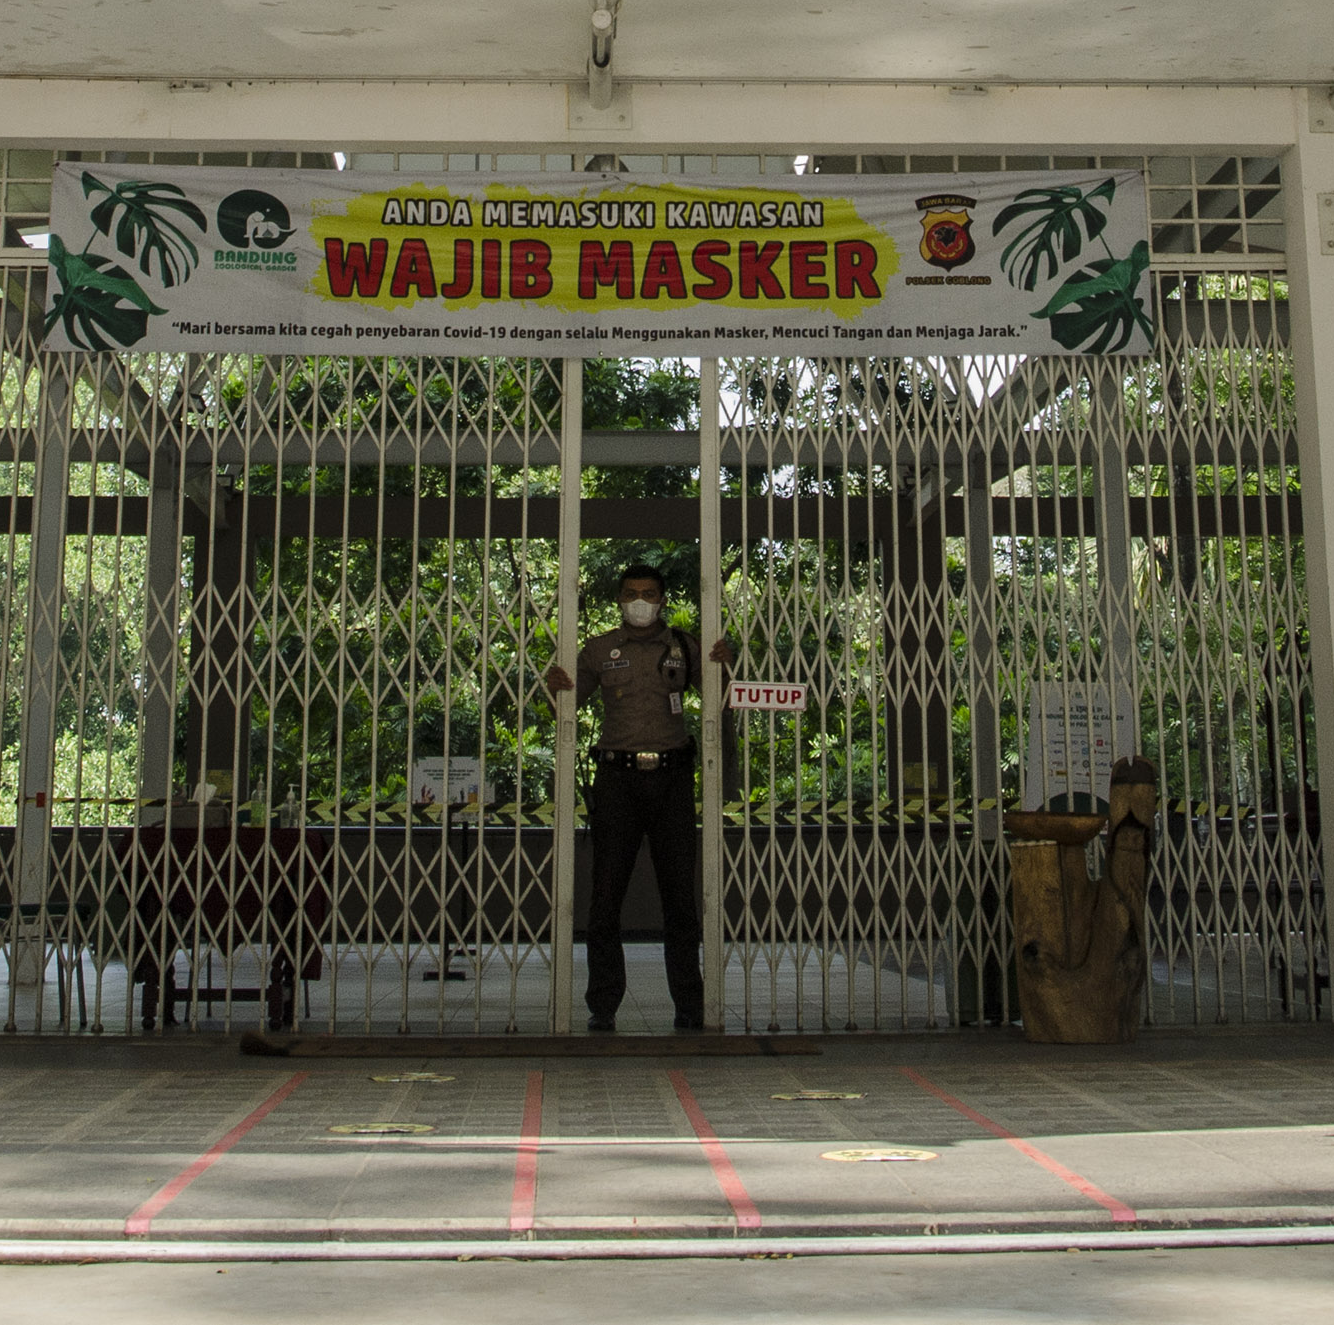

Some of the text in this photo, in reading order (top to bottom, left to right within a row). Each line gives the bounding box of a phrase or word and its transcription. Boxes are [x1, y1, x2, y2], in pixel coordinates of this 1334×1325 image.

[383, 198, 824, 229] ANDA MEMASUKI KAWASAN
[214, 250, 297, 264] BANDUNG
[214, 263, 262, 271] ZOOLOGICAL
[324, 236, 882, 301] WAJIB MASKER
[905, 276, 944, 286] POLSEK
[214, 321, 276, 336] bersama
[279, 322, 307, 336] kita
[310, 323, 353, 339] cegah
[355, 324, 440, 340] penyebaran
[443, 326, 506, 339] Covid-19
[509, 326, 562, 342] dengan
[565, 326, 608, 339] selalu
[611, 326, 711, 342] Menggunakan
[714, 326, 769, 340] Masker,
[772, 325, 829, 339] Mencuci
[832, 325, 883, 341] Tangan
[886, 325, 913, 339] dan
[915, 324, 975, 341] Menjaga
[734, 688, 802, 705] TUTUP
